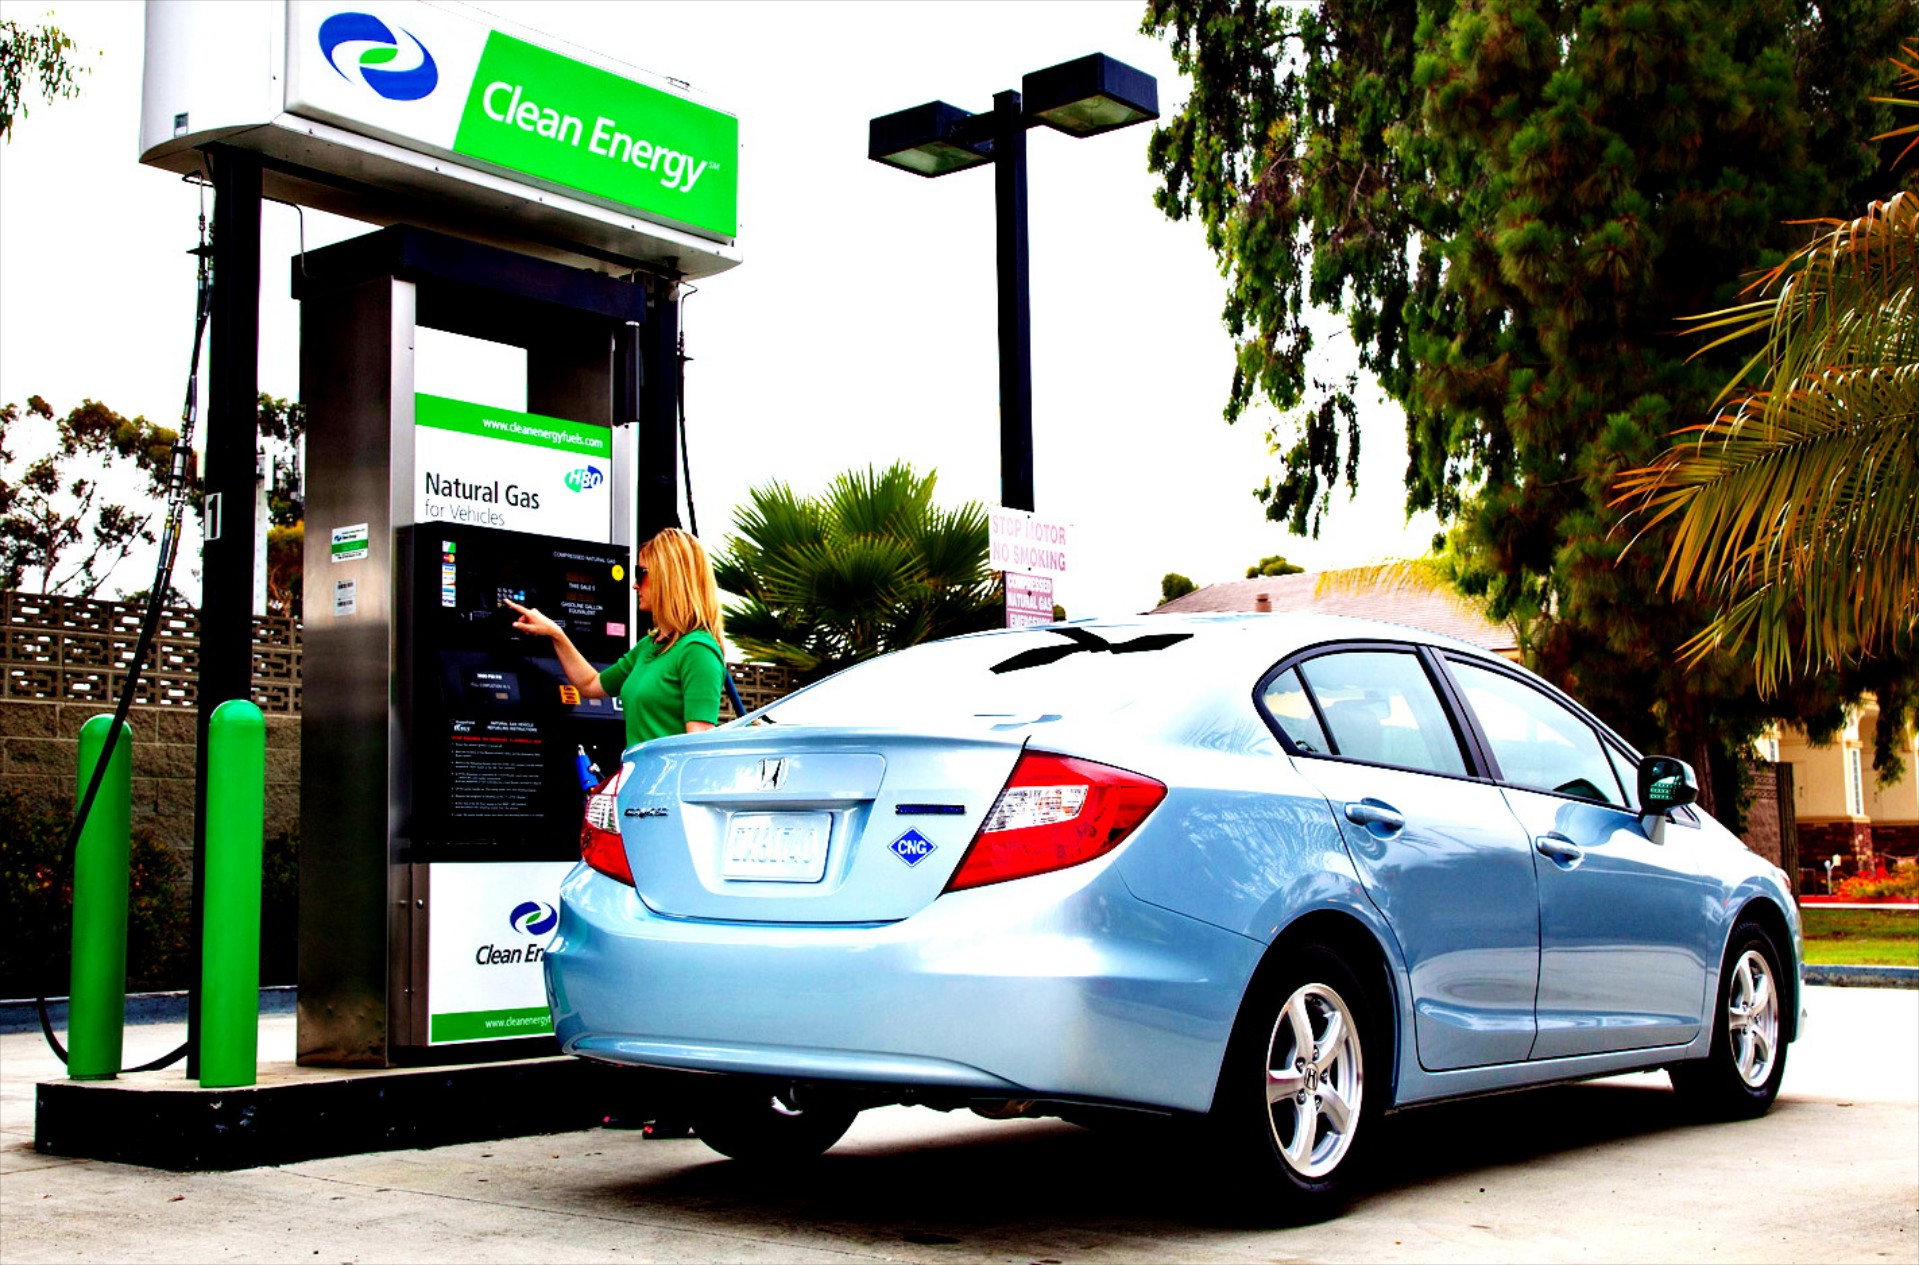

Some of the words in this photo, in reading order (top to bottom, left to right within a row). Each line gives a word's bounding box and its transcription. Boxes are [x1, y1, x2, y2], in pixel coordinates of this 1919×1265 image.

[482, 80, 584, 147] Clean
[587, 115, 708, 193] Energy
[482, 416, 604, 449] www.cleanenergyfuels.com
[425, 471, 499, 504] Natural
[505, 484, 541, 510] Gas
[424, 498, 445, 518] for
[450, 503, 506, 527] Vehicles
[992, 514, 1022, 537] STOP
[1025, 520, 1067, 546] MOTOR
[992, 541, 1010, 563] NO
[1013, 544, 1067, 572] SMOKING
[897, 839, 928, 855] CNG
[475, 944, 522, 965] Clean
